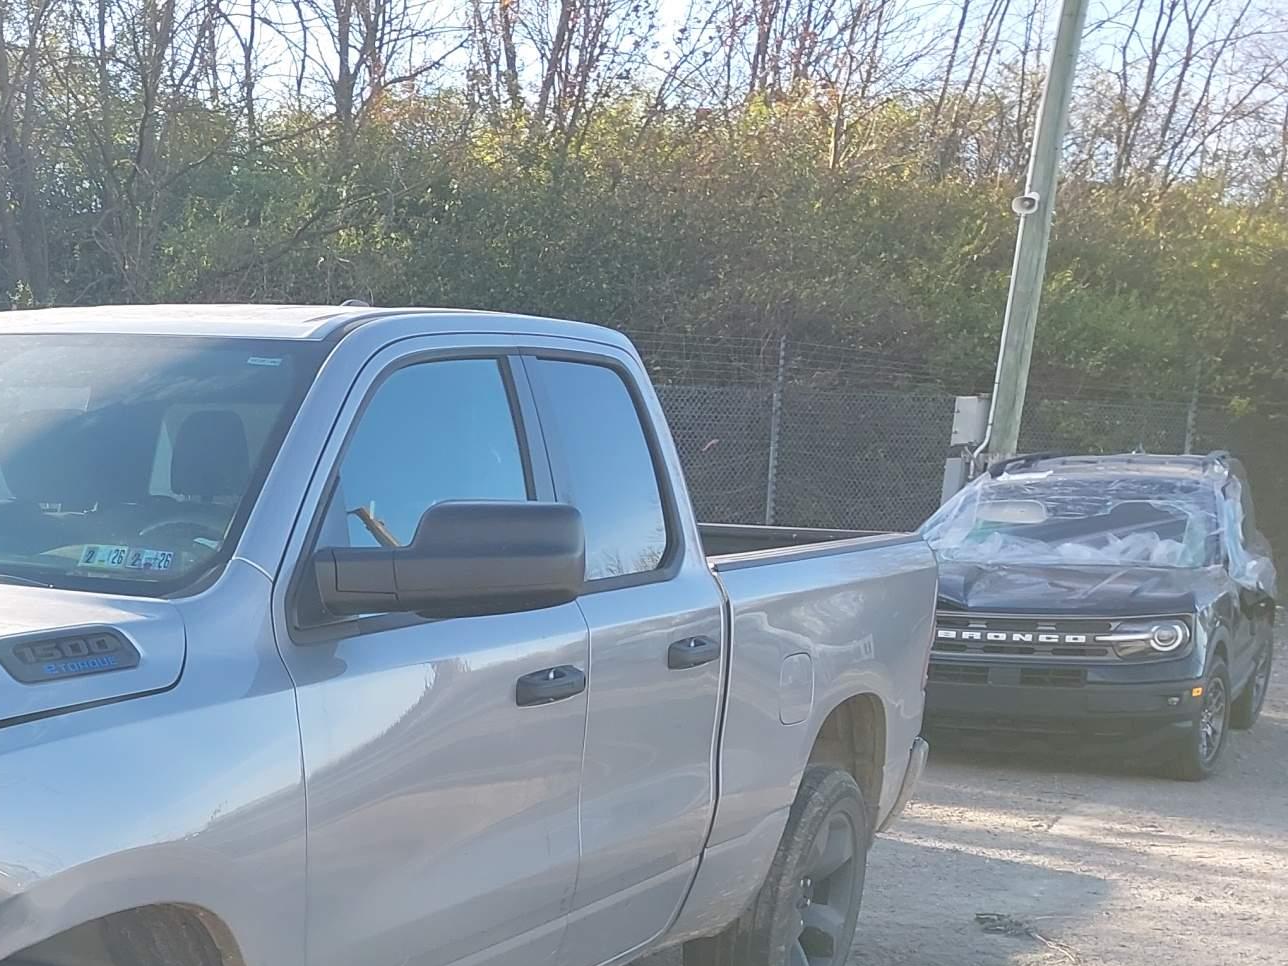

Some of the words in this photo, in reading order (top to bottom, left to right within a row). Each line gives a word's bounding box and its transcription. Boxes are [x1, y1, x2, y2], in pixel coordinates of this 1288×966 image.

[111, 549, 126, 565] 26
[158, 551, 172, 568] 26
[937, 629, 1087, 644] BRONCO
[13, 636, 113, 663] 1500
